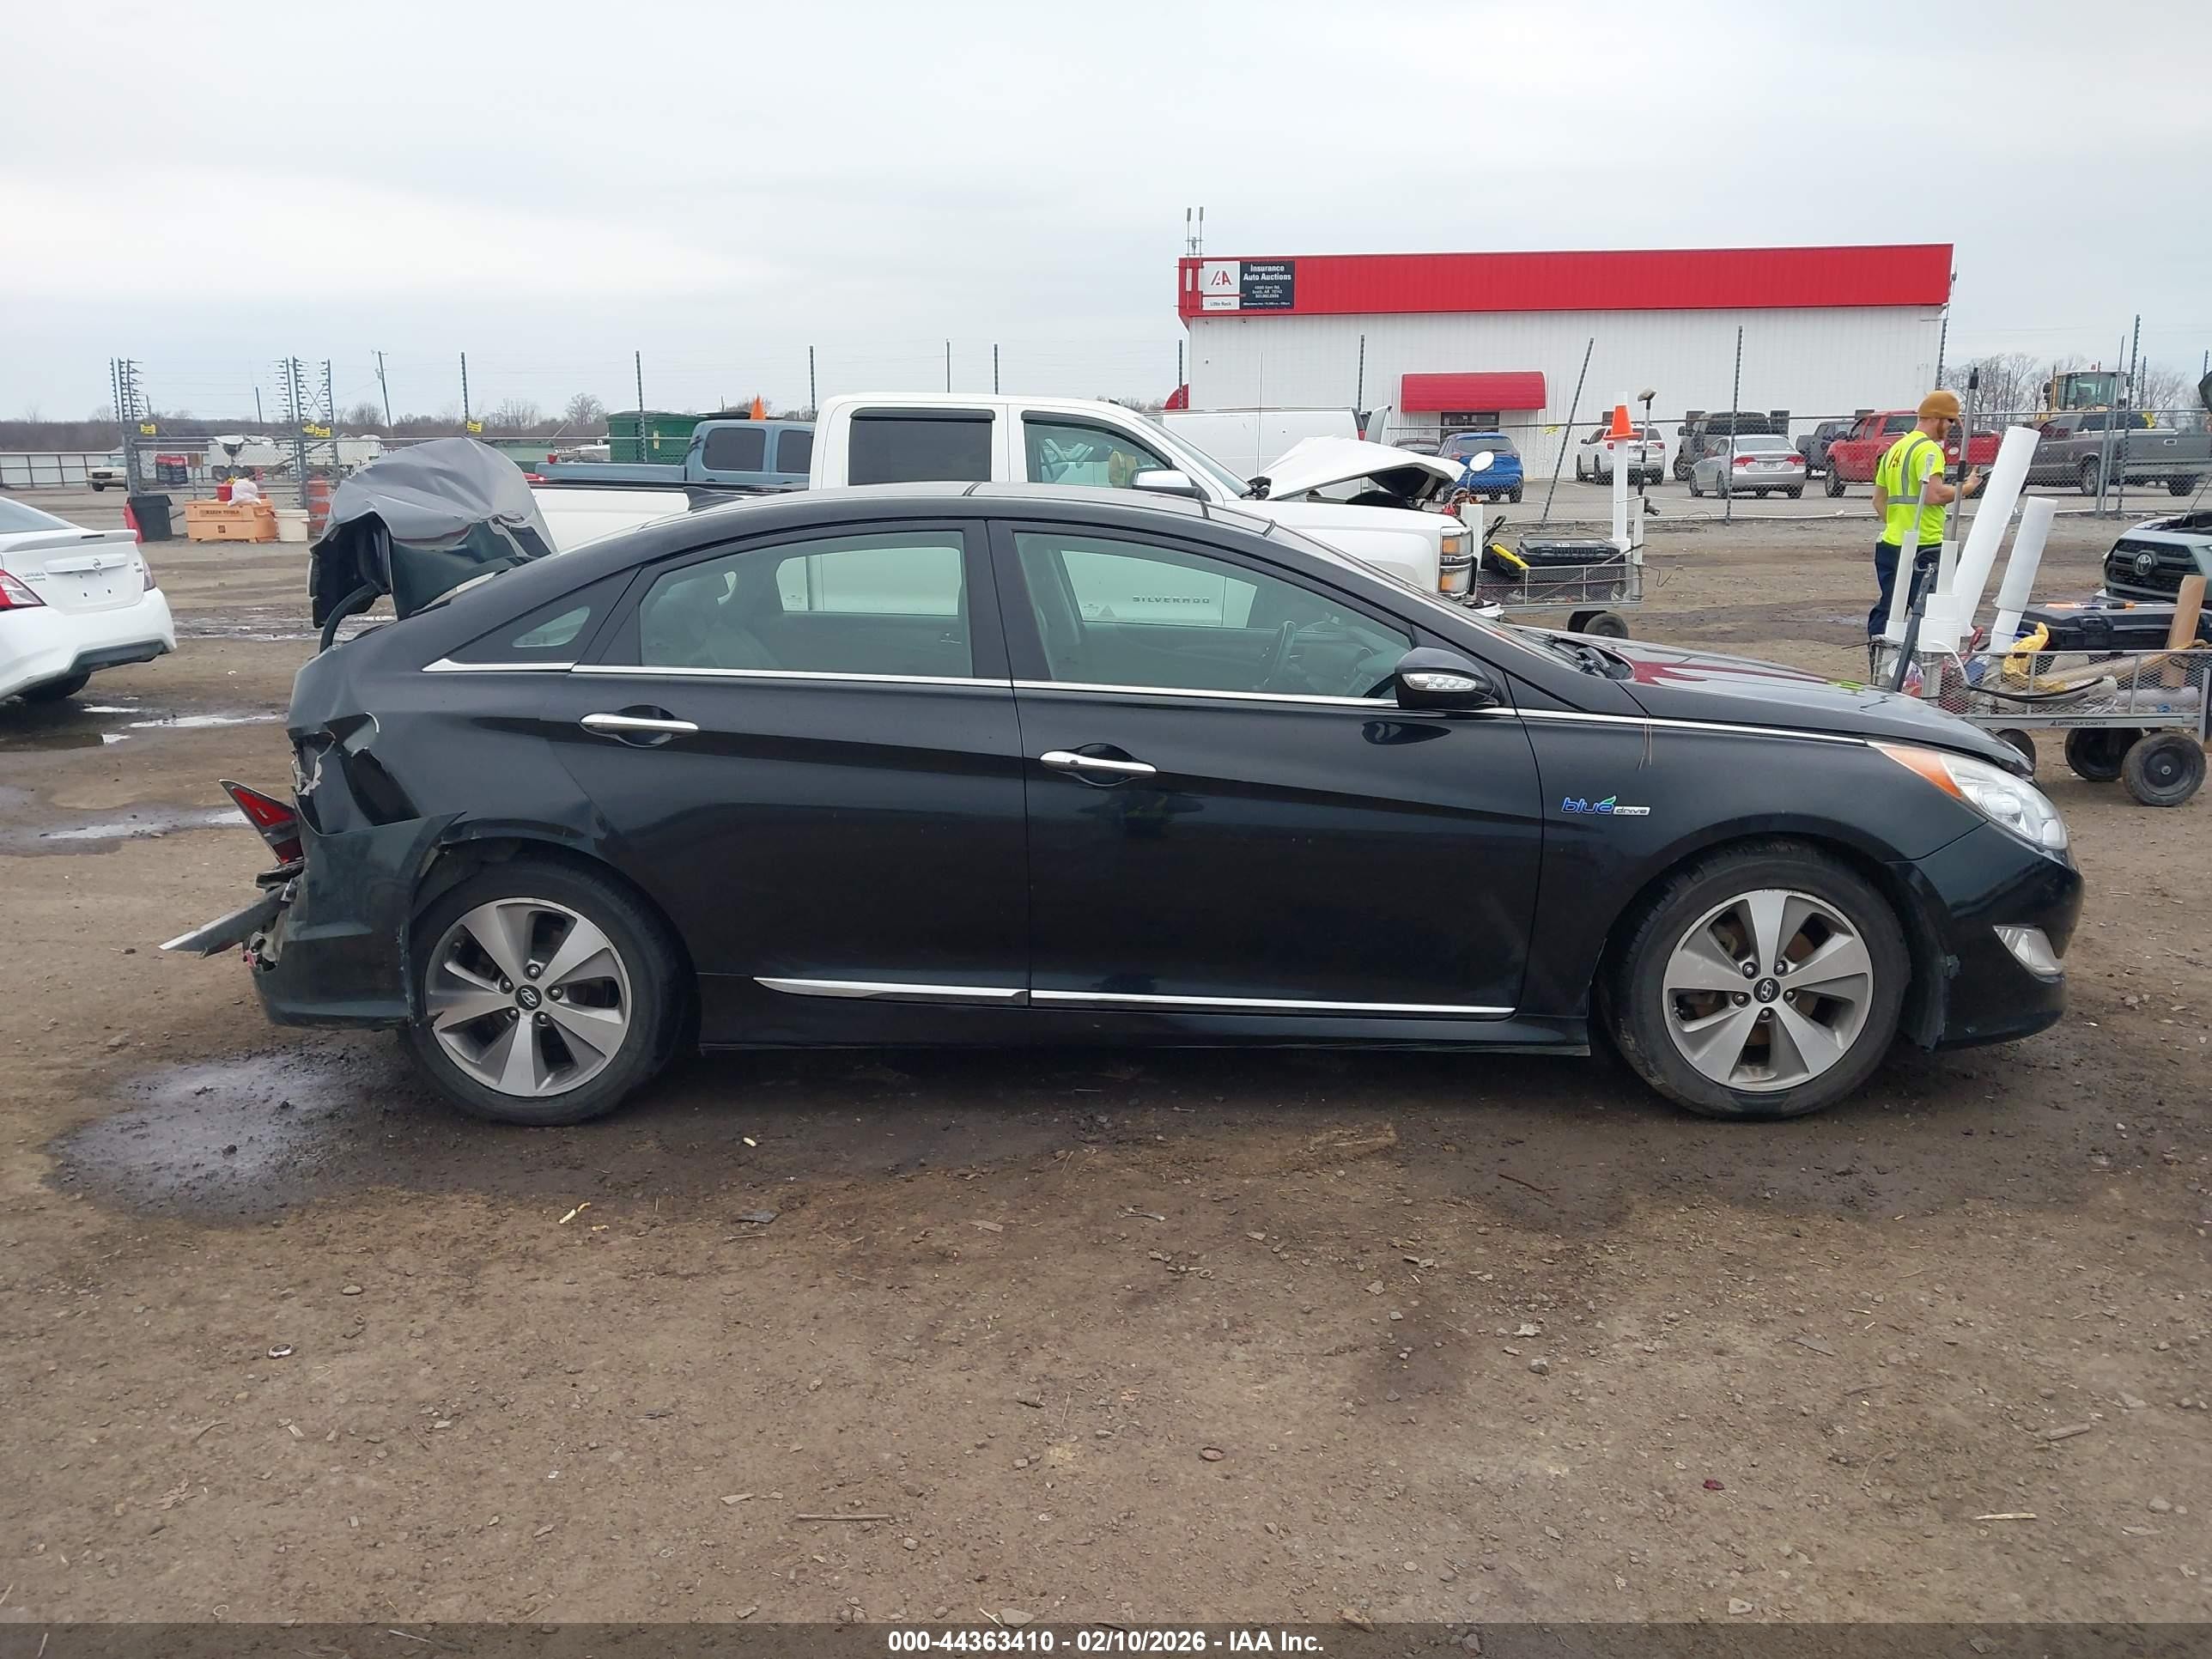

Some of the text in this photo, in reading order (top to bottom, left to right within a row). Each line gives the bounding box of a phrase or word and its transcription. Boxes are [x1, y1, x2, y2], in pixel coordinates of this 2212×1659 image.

[1250, 264, 1285, 272] Insurance
[1261, 272, 1291, 281] Auctions
[1562, 796, 1614, 814] blue
